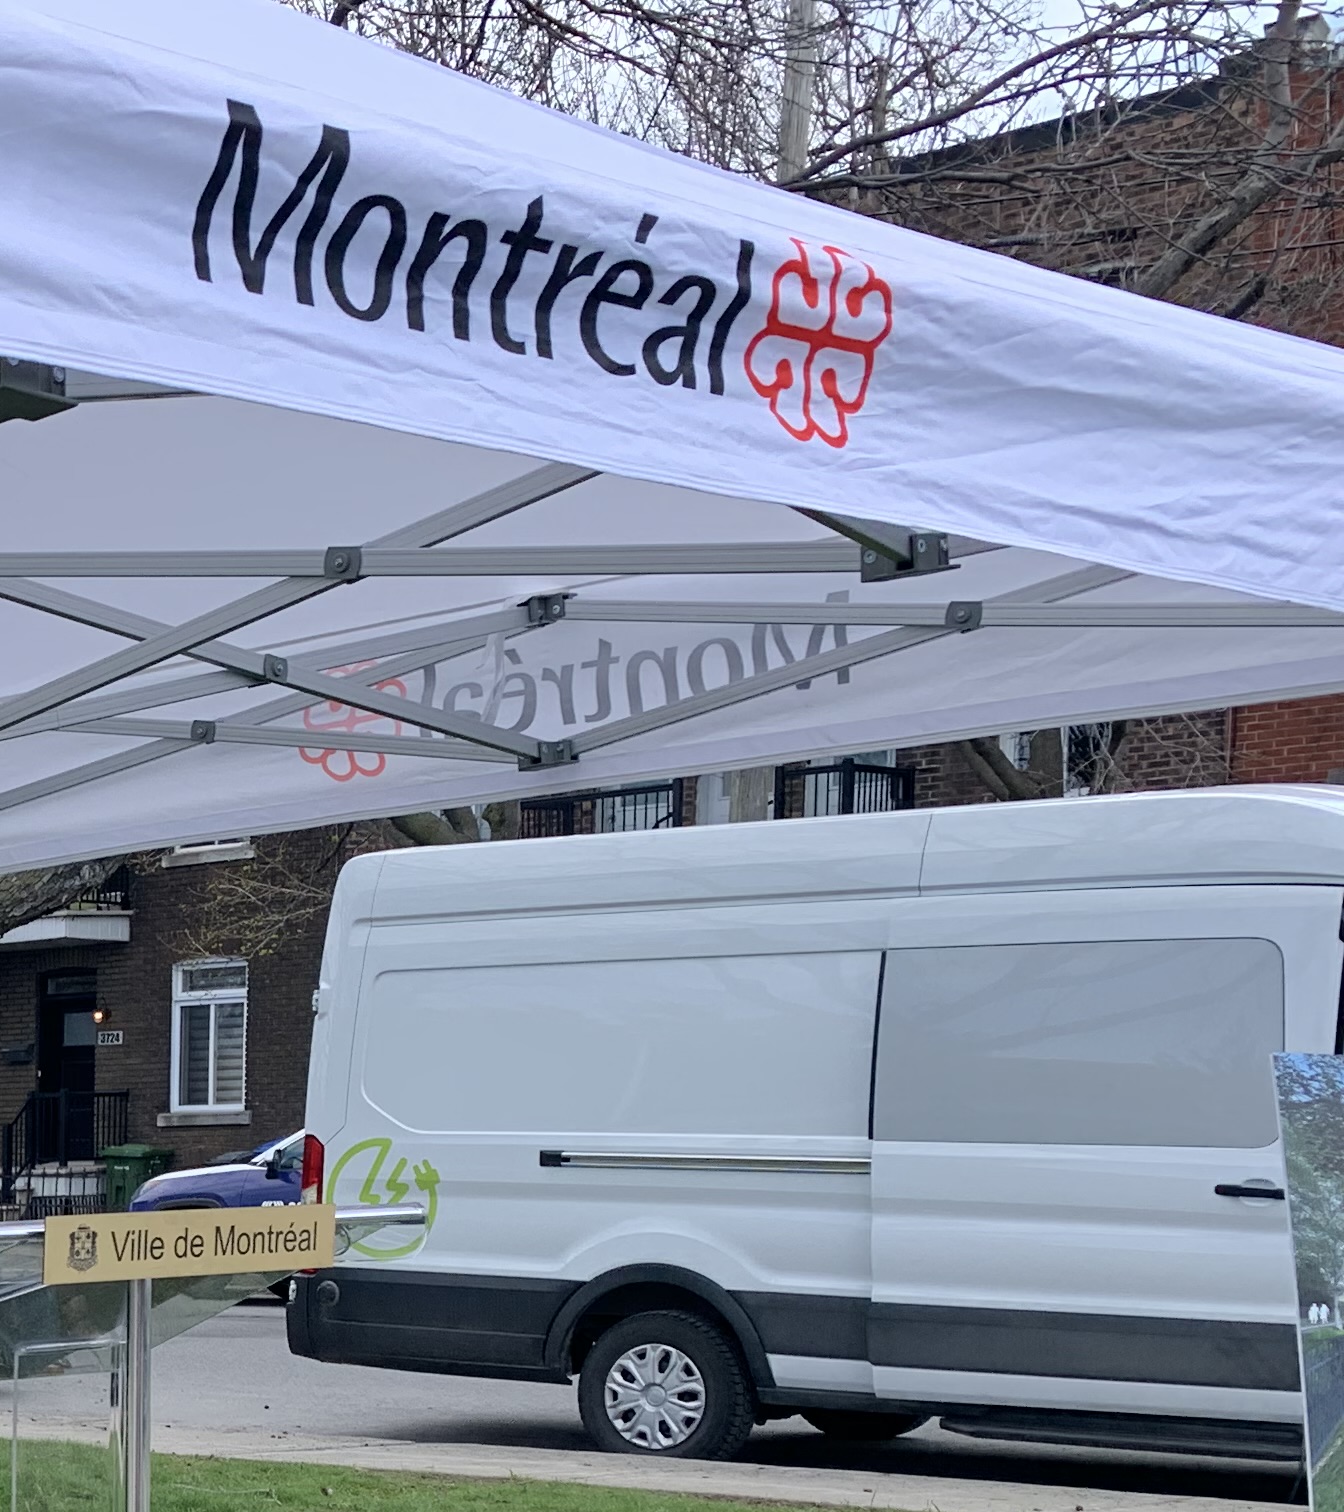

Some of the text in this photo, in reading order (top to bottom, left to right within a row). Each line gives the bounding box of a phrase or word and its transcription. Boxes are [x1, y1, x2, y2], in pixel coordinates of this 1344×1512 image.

[192, 98, 755, 396] Montréal
[111, 1221, 318, 1262] Ville de Montréal
